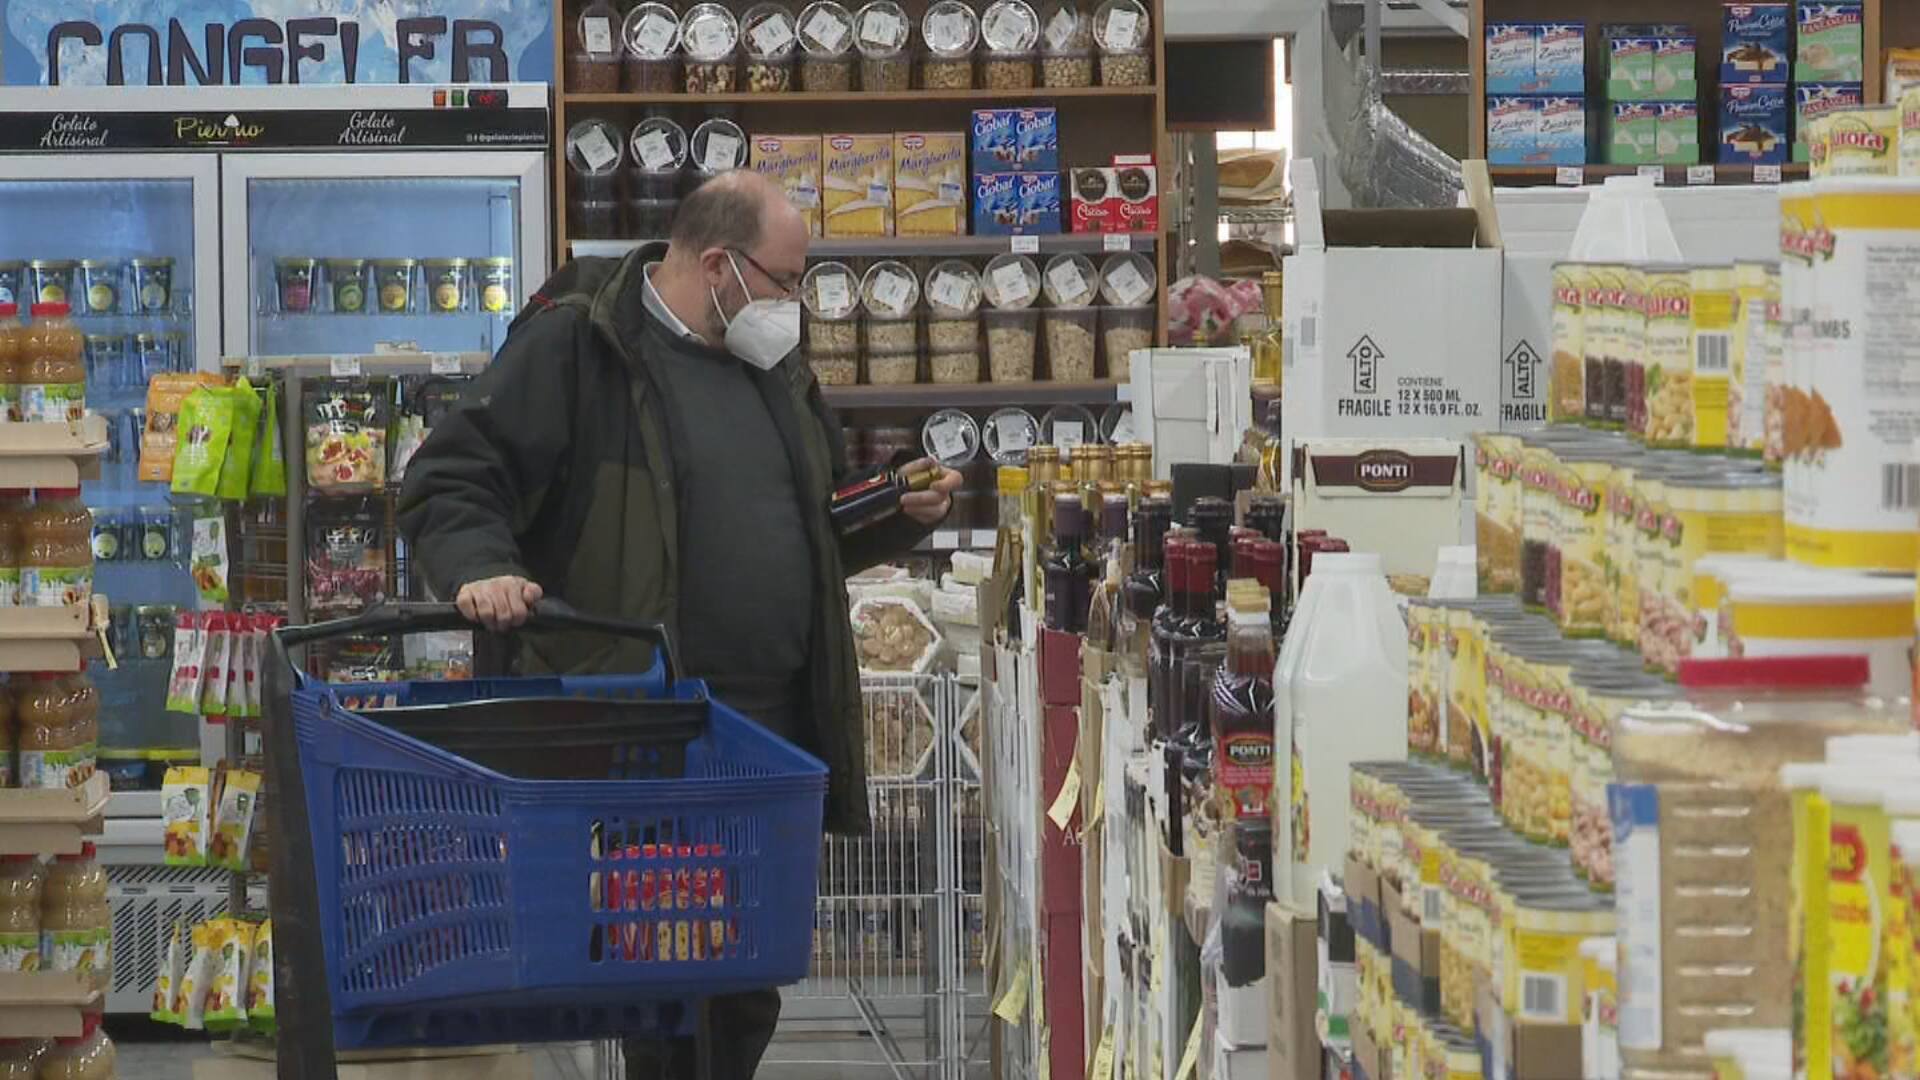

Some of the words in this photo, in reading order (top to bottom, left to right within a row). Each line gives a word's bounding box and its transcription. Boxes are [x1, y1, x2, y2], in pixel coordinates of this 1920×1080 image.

[52, 113, 97, 132] Gelato
[349, 111, 395, 130] Gelato
[974, 111, 1012, 137] Ciobar
[1016, 111, 1056, 135] Ciobar
[977, 175, 1014, 200] Ciobar
[1019, 174, 1056, 199] Ciobar
[1359, 345, 1372, 389] ALTO
[1517, 351, 1530, 394] ALTO
[1397, 377, 1444, 387] CONTIENE
[1398, 389, 1410, 401] 12
[1413, 389, 1421, 401] X
[1423, 389, 1443, 402] 500
[1445, 389, 1461, 401] ML
[1338, 399, 1392, 417] FRAGILE
[1398, 403, 1410, 415] 12
[1413, 403, 1421, 415] X
[1360, 462, 1408, 478] PONTI
[1229, 744, 1270, 757] PONTI
